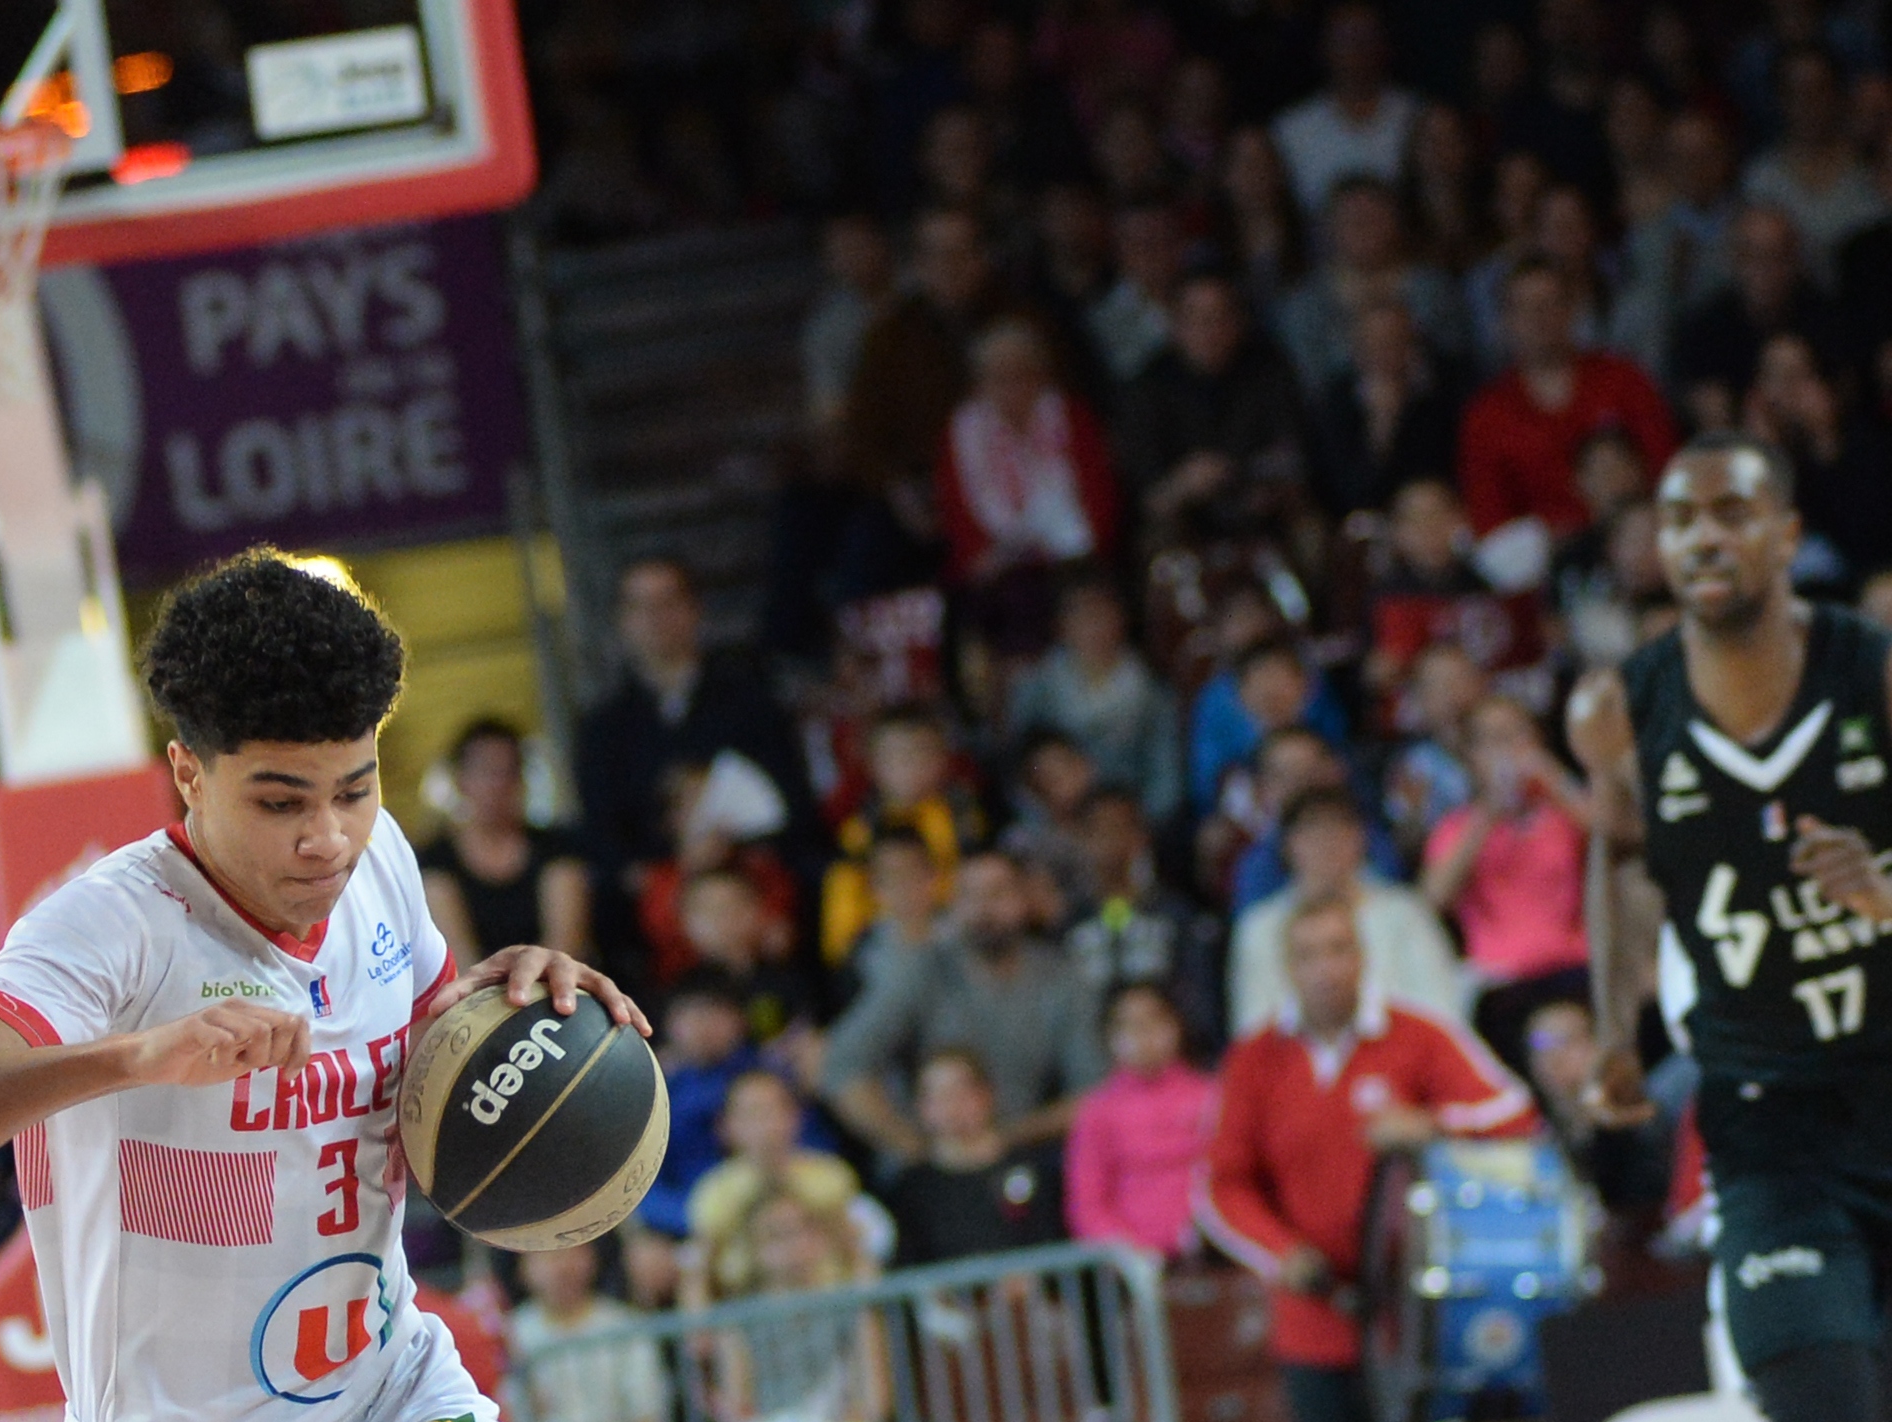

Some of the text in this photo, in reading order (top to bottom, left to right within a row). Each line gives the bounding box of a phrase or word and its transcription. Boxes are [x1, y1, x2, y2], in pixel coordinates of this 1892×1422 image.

[176, 242, 448, 375] PAYS
[164, 397, 468, 531] LOIRE
[1792, 963, 1866, 1043] 17
[470, 1018, 567, 1125] Jeep
[316, 1138, 360, 1237] 3
[294, 1297, 372, 1381] U
